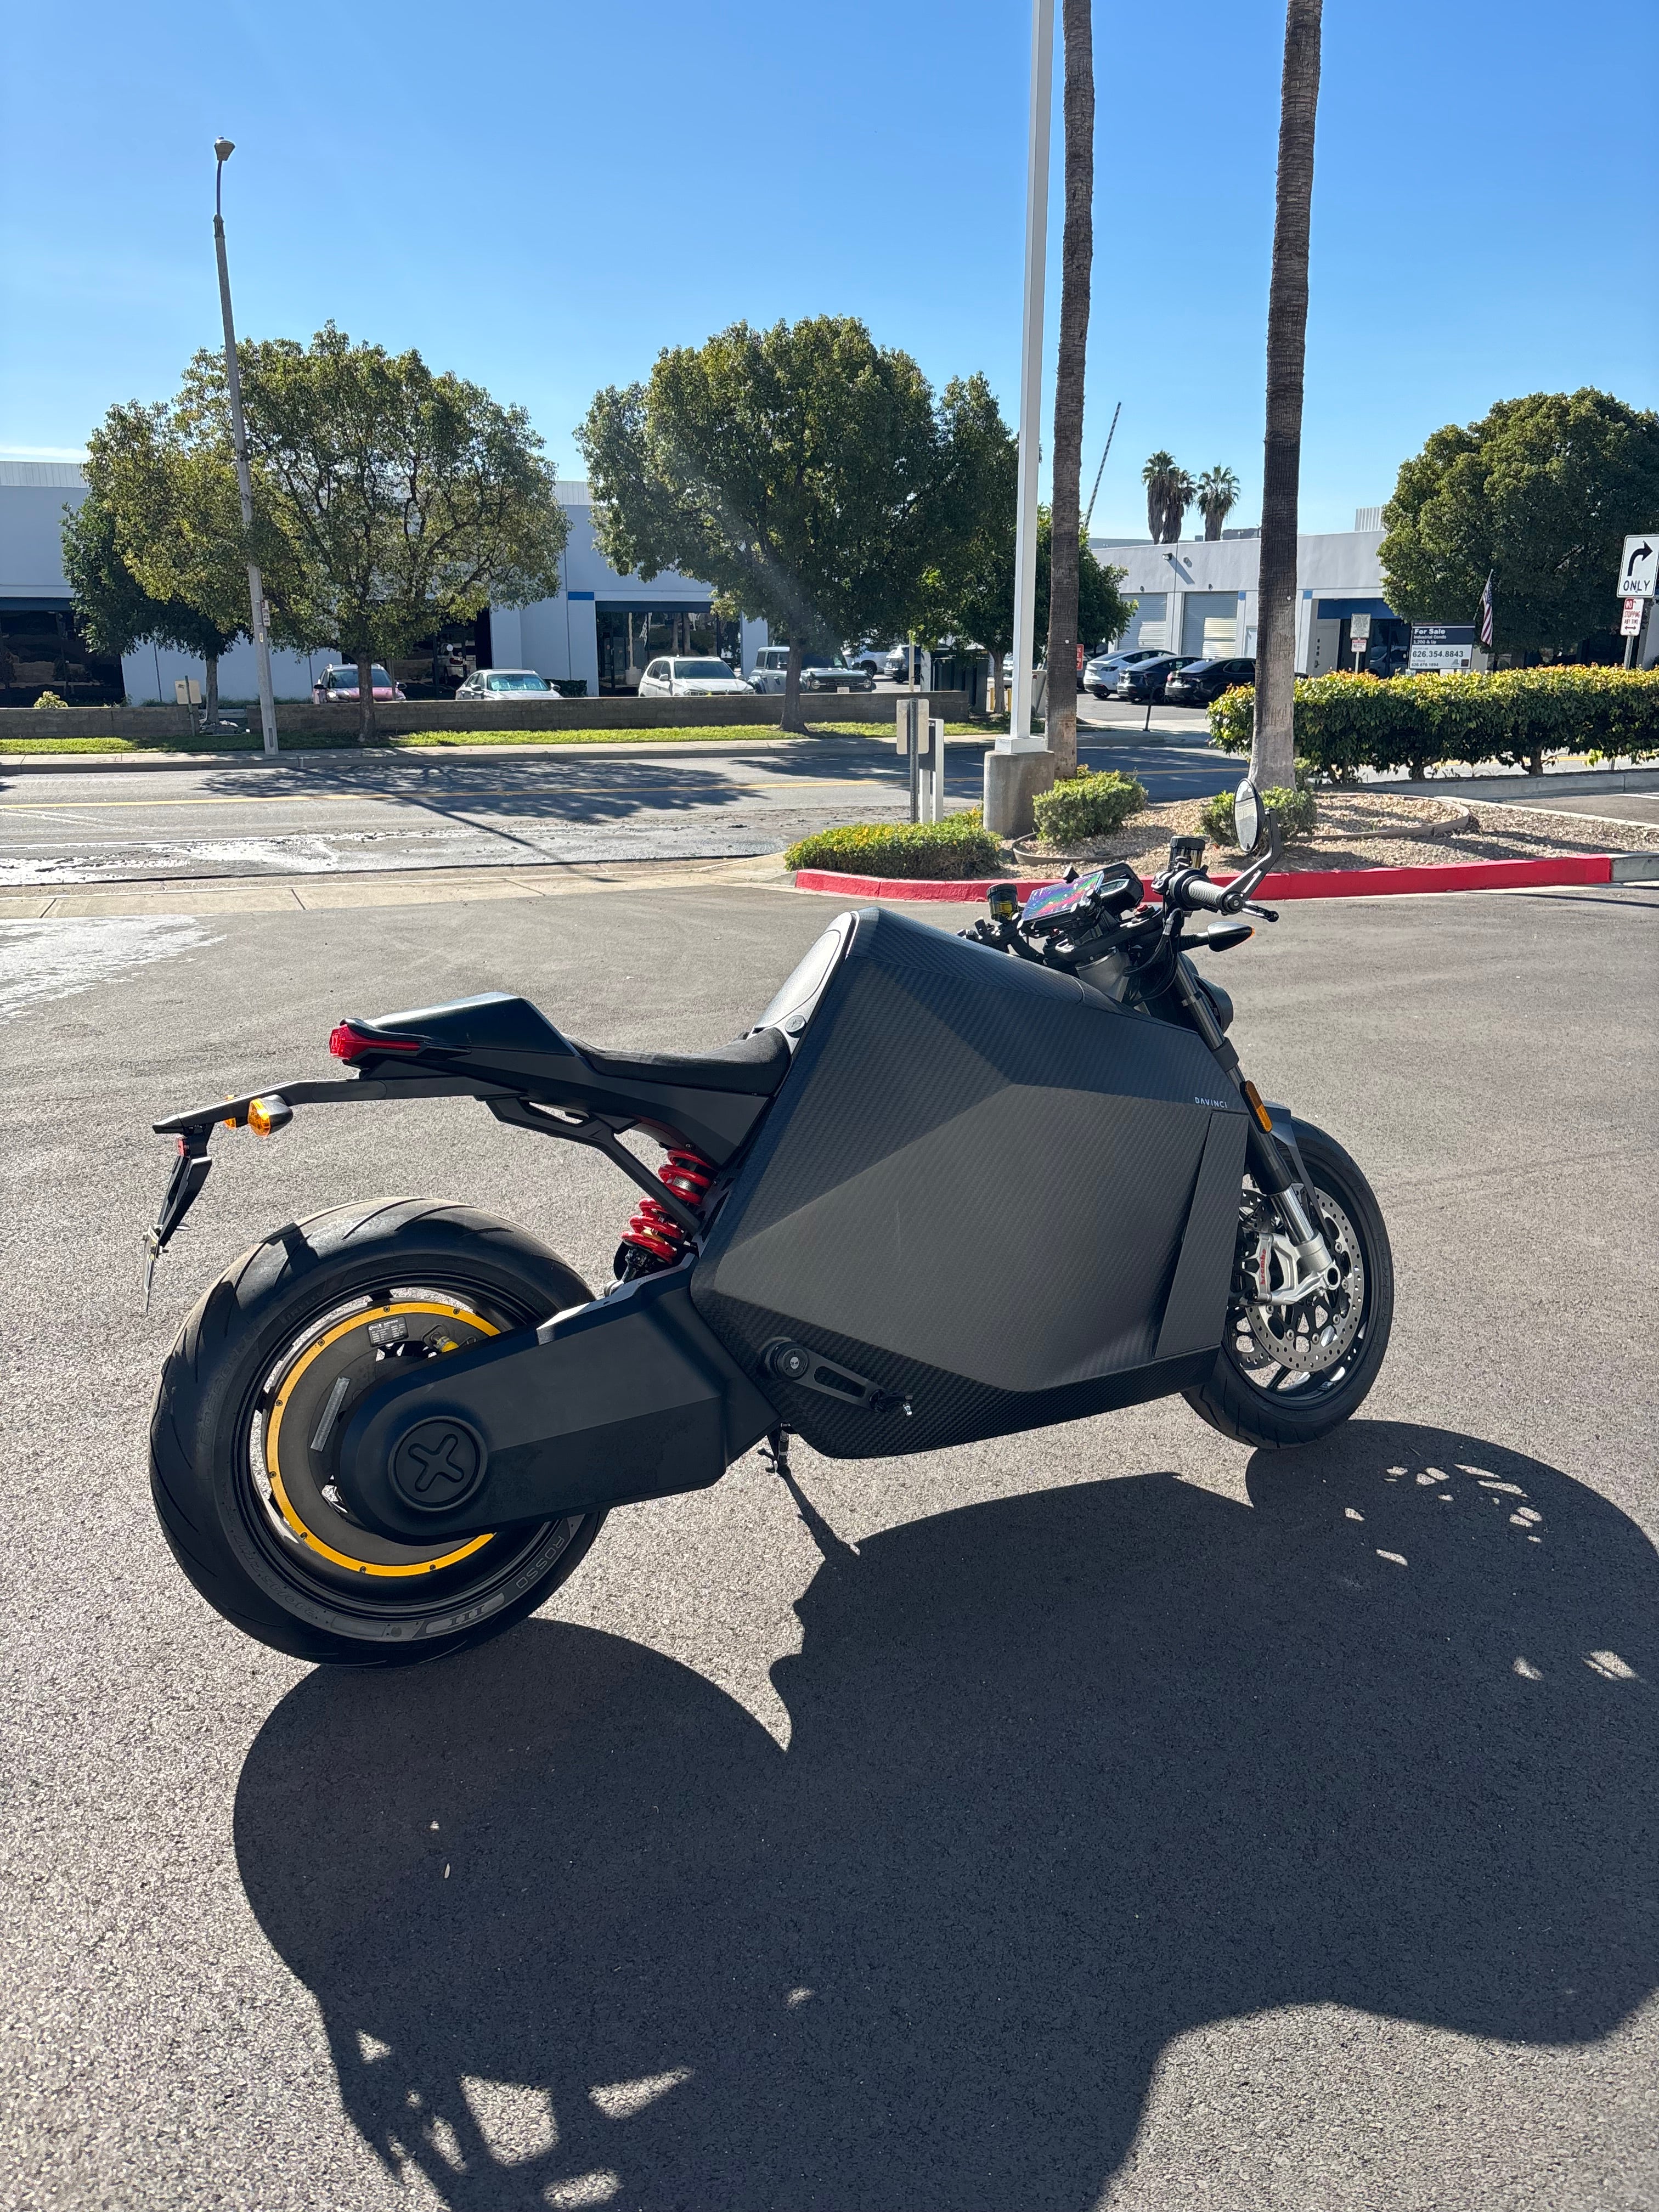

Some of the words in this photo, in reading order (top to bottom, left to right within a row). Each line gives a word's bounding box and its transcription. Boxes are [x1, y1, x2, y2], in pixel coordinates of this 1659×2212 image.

[1623, 580, 1651, 591] ONLY
[1194, 1097, 1227, 1108] DAVINCI
[516, 1534, 565, 1589] ROSSO
[450, 1605, 485, 1626] III
